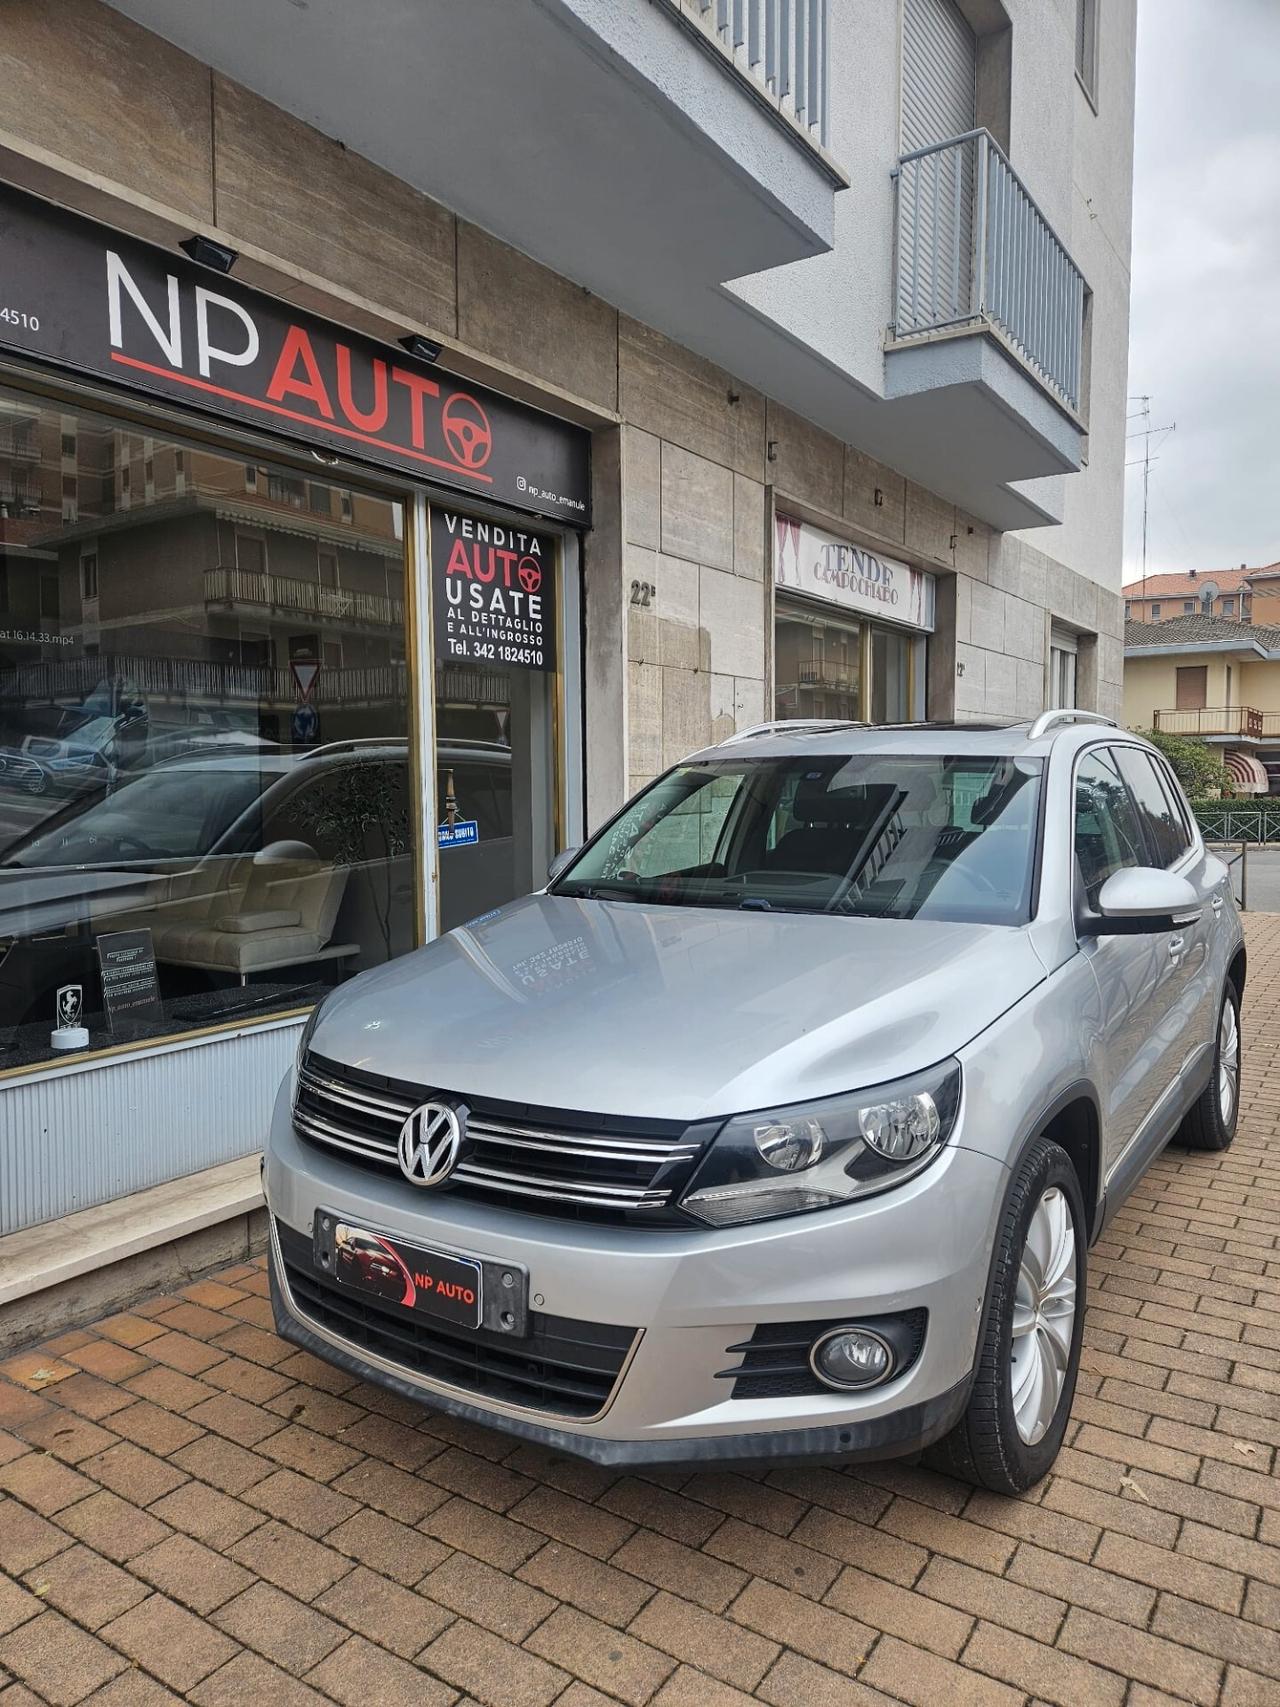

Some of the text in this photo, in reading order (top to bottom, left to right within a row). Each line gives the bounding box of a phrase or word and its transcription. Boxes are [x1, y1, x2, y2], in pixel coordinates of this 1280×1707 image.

[444, 513, 542, 556] VENDITA
[446, 538, 542, 593] AUTO
[446, 577, 542, 620] USATE
[447, 606, 543, 633] AL DETTAGLIO
[447, 621, 543, 646] E ALL'INGROSSO
[447, 638, 543, 665] Tel. 342 1824510
[415, 1272, 474, 1304] NP AUTO
